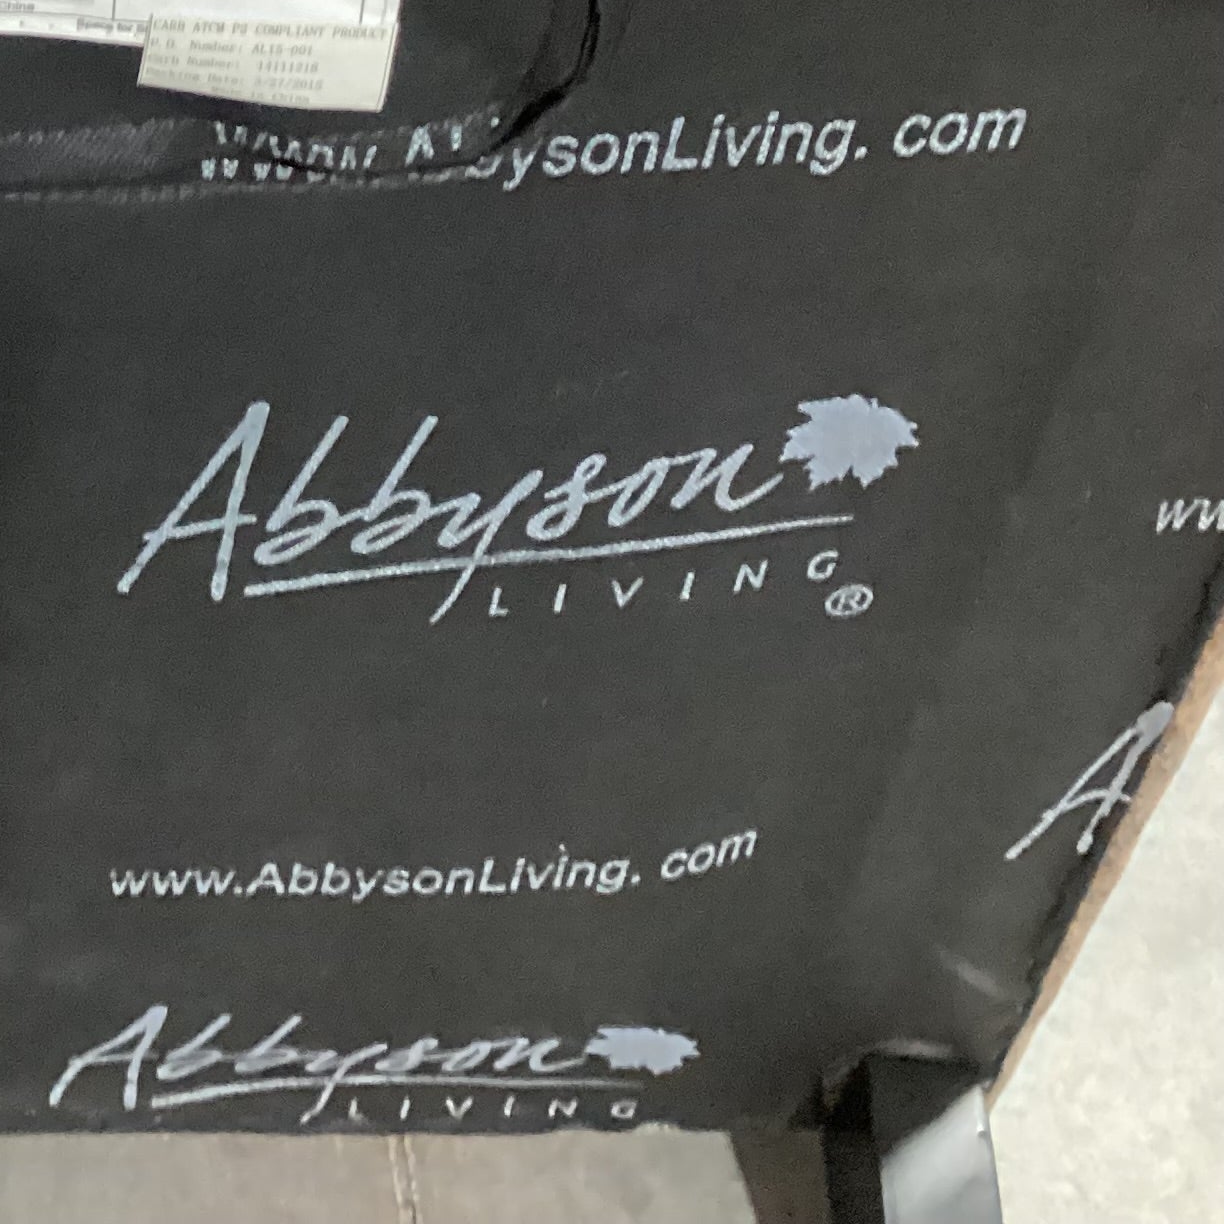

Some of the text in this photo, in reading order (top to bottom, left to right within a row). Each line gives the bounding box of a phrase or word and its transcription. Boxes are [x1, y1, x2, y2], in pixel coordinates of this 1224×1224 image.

[893, 107, 1026, 157] com
[117, 401, 783, 624] Abbyson
[489, 550, 839, 617] LIVING
[110, 827, 758, 902] www.AbbysonLiving. com
[50, 1005, 585, 1124] Abbyson
[348, 1097, 636, 1119] LIVING
